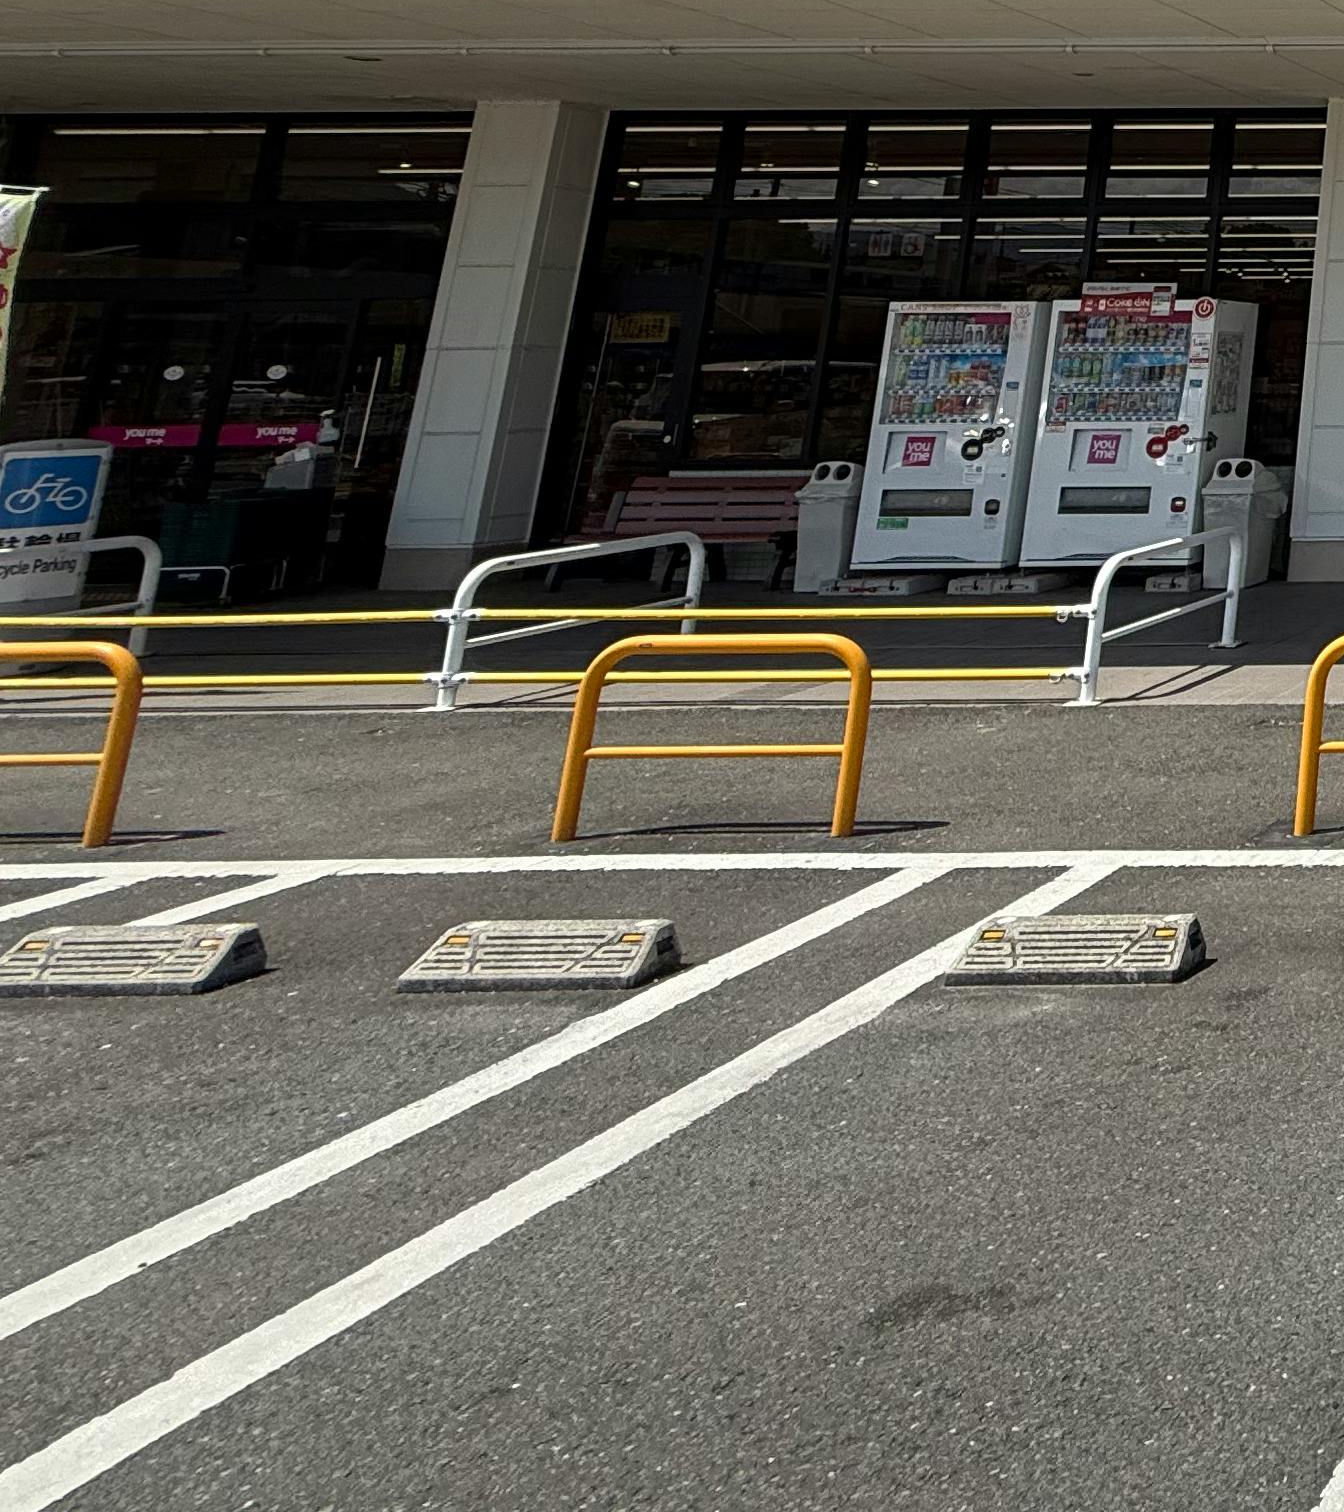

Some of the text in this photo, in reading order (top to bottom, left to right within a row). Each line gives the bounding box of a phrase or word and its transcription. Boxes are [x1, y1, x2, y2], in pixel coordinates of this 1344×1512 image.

[907, 441, 930, 453] you
[1092, 440, 1116, 451] you
[909, 452, 930, 462] me
[1095, 449, 1116, 459] me
[32, 557, 78, 575] Parking
